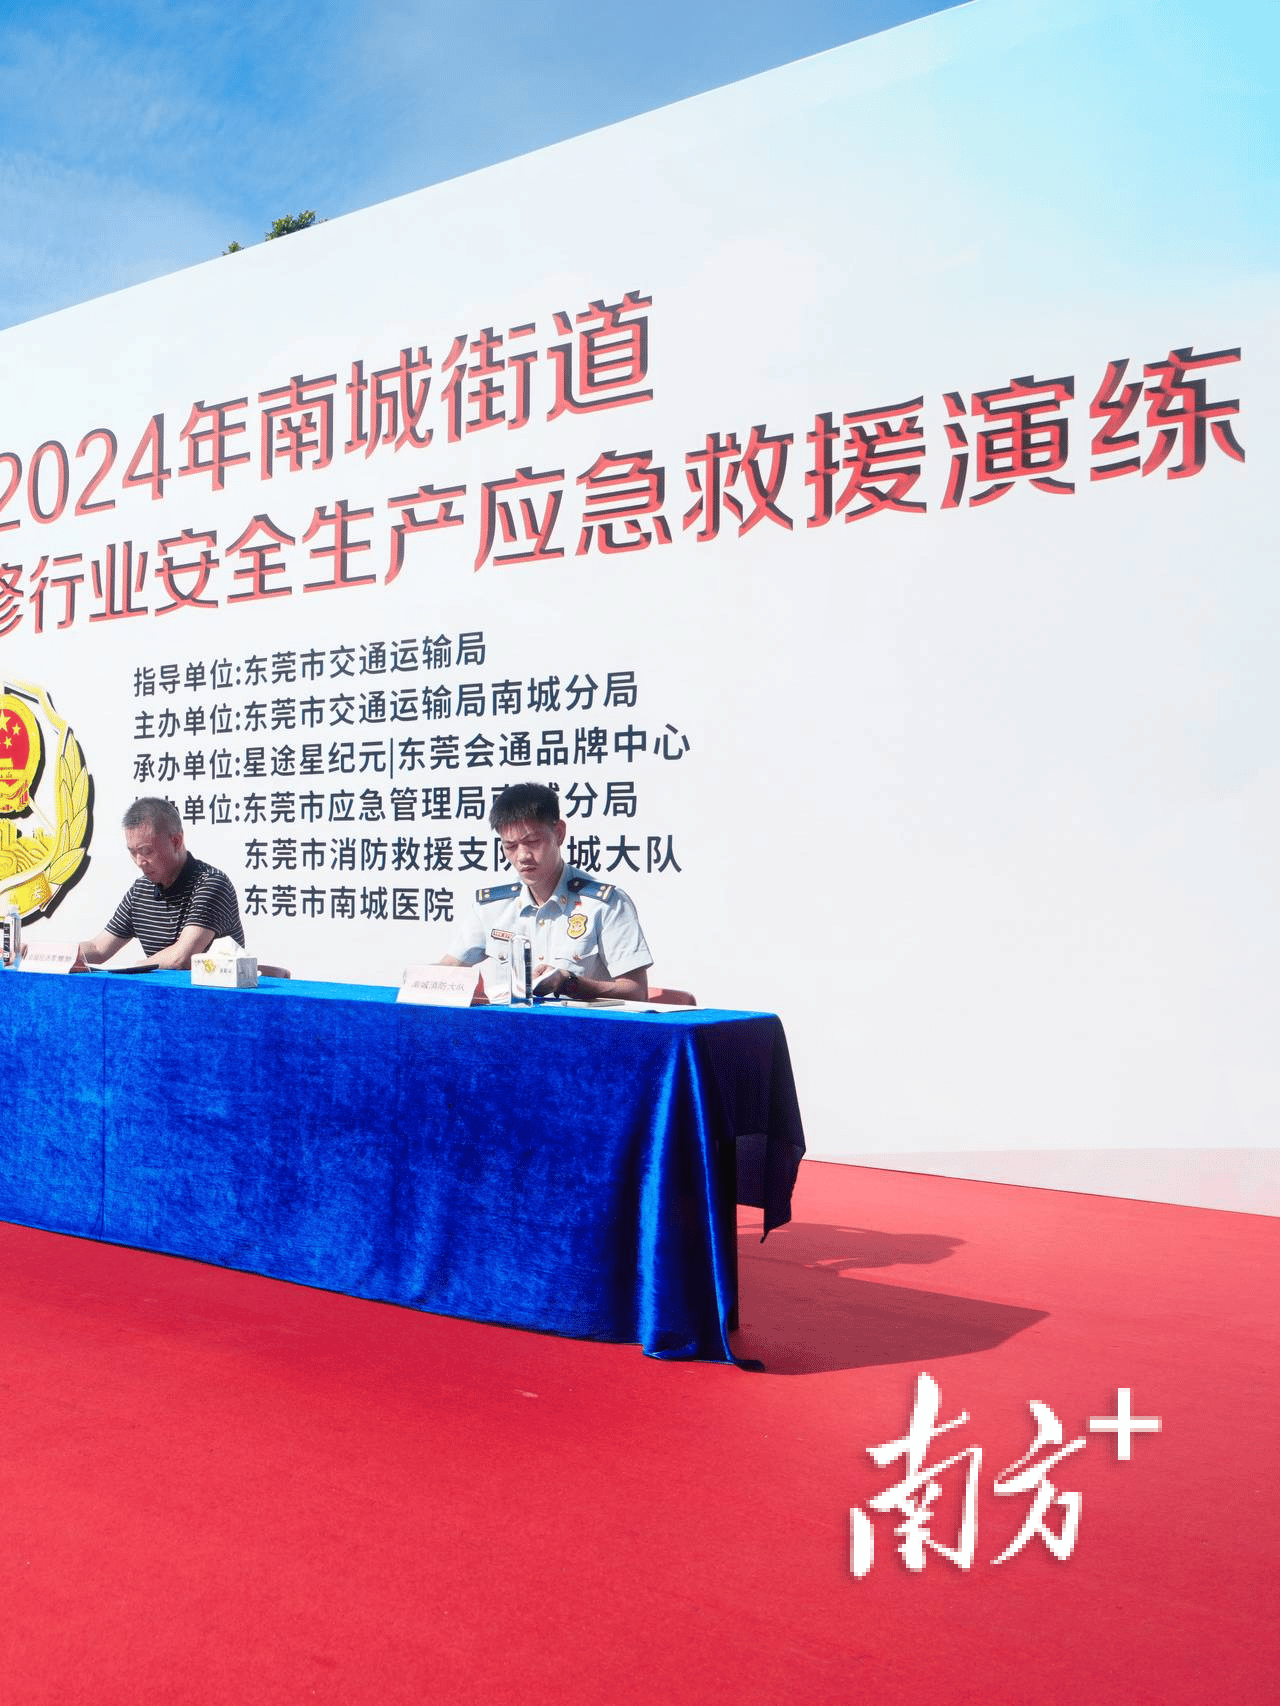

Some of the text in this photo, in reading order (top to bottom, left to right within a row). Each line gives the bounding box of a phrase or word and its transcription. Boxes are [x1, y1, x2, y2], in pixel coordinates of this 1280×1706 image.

[133, 631, 487, 698] 指导单位:东莞市交通运输局
[133, 670, 639, 739] 主办单位:东莞市交通运输局南城分局
[135, 781, 639, 826] 单位:东莞市应急管理局分局
[244, 834, 682, 874] 东莞市消防救援支城大队
[244, 884, 455, 922] 东莞市南城医院
